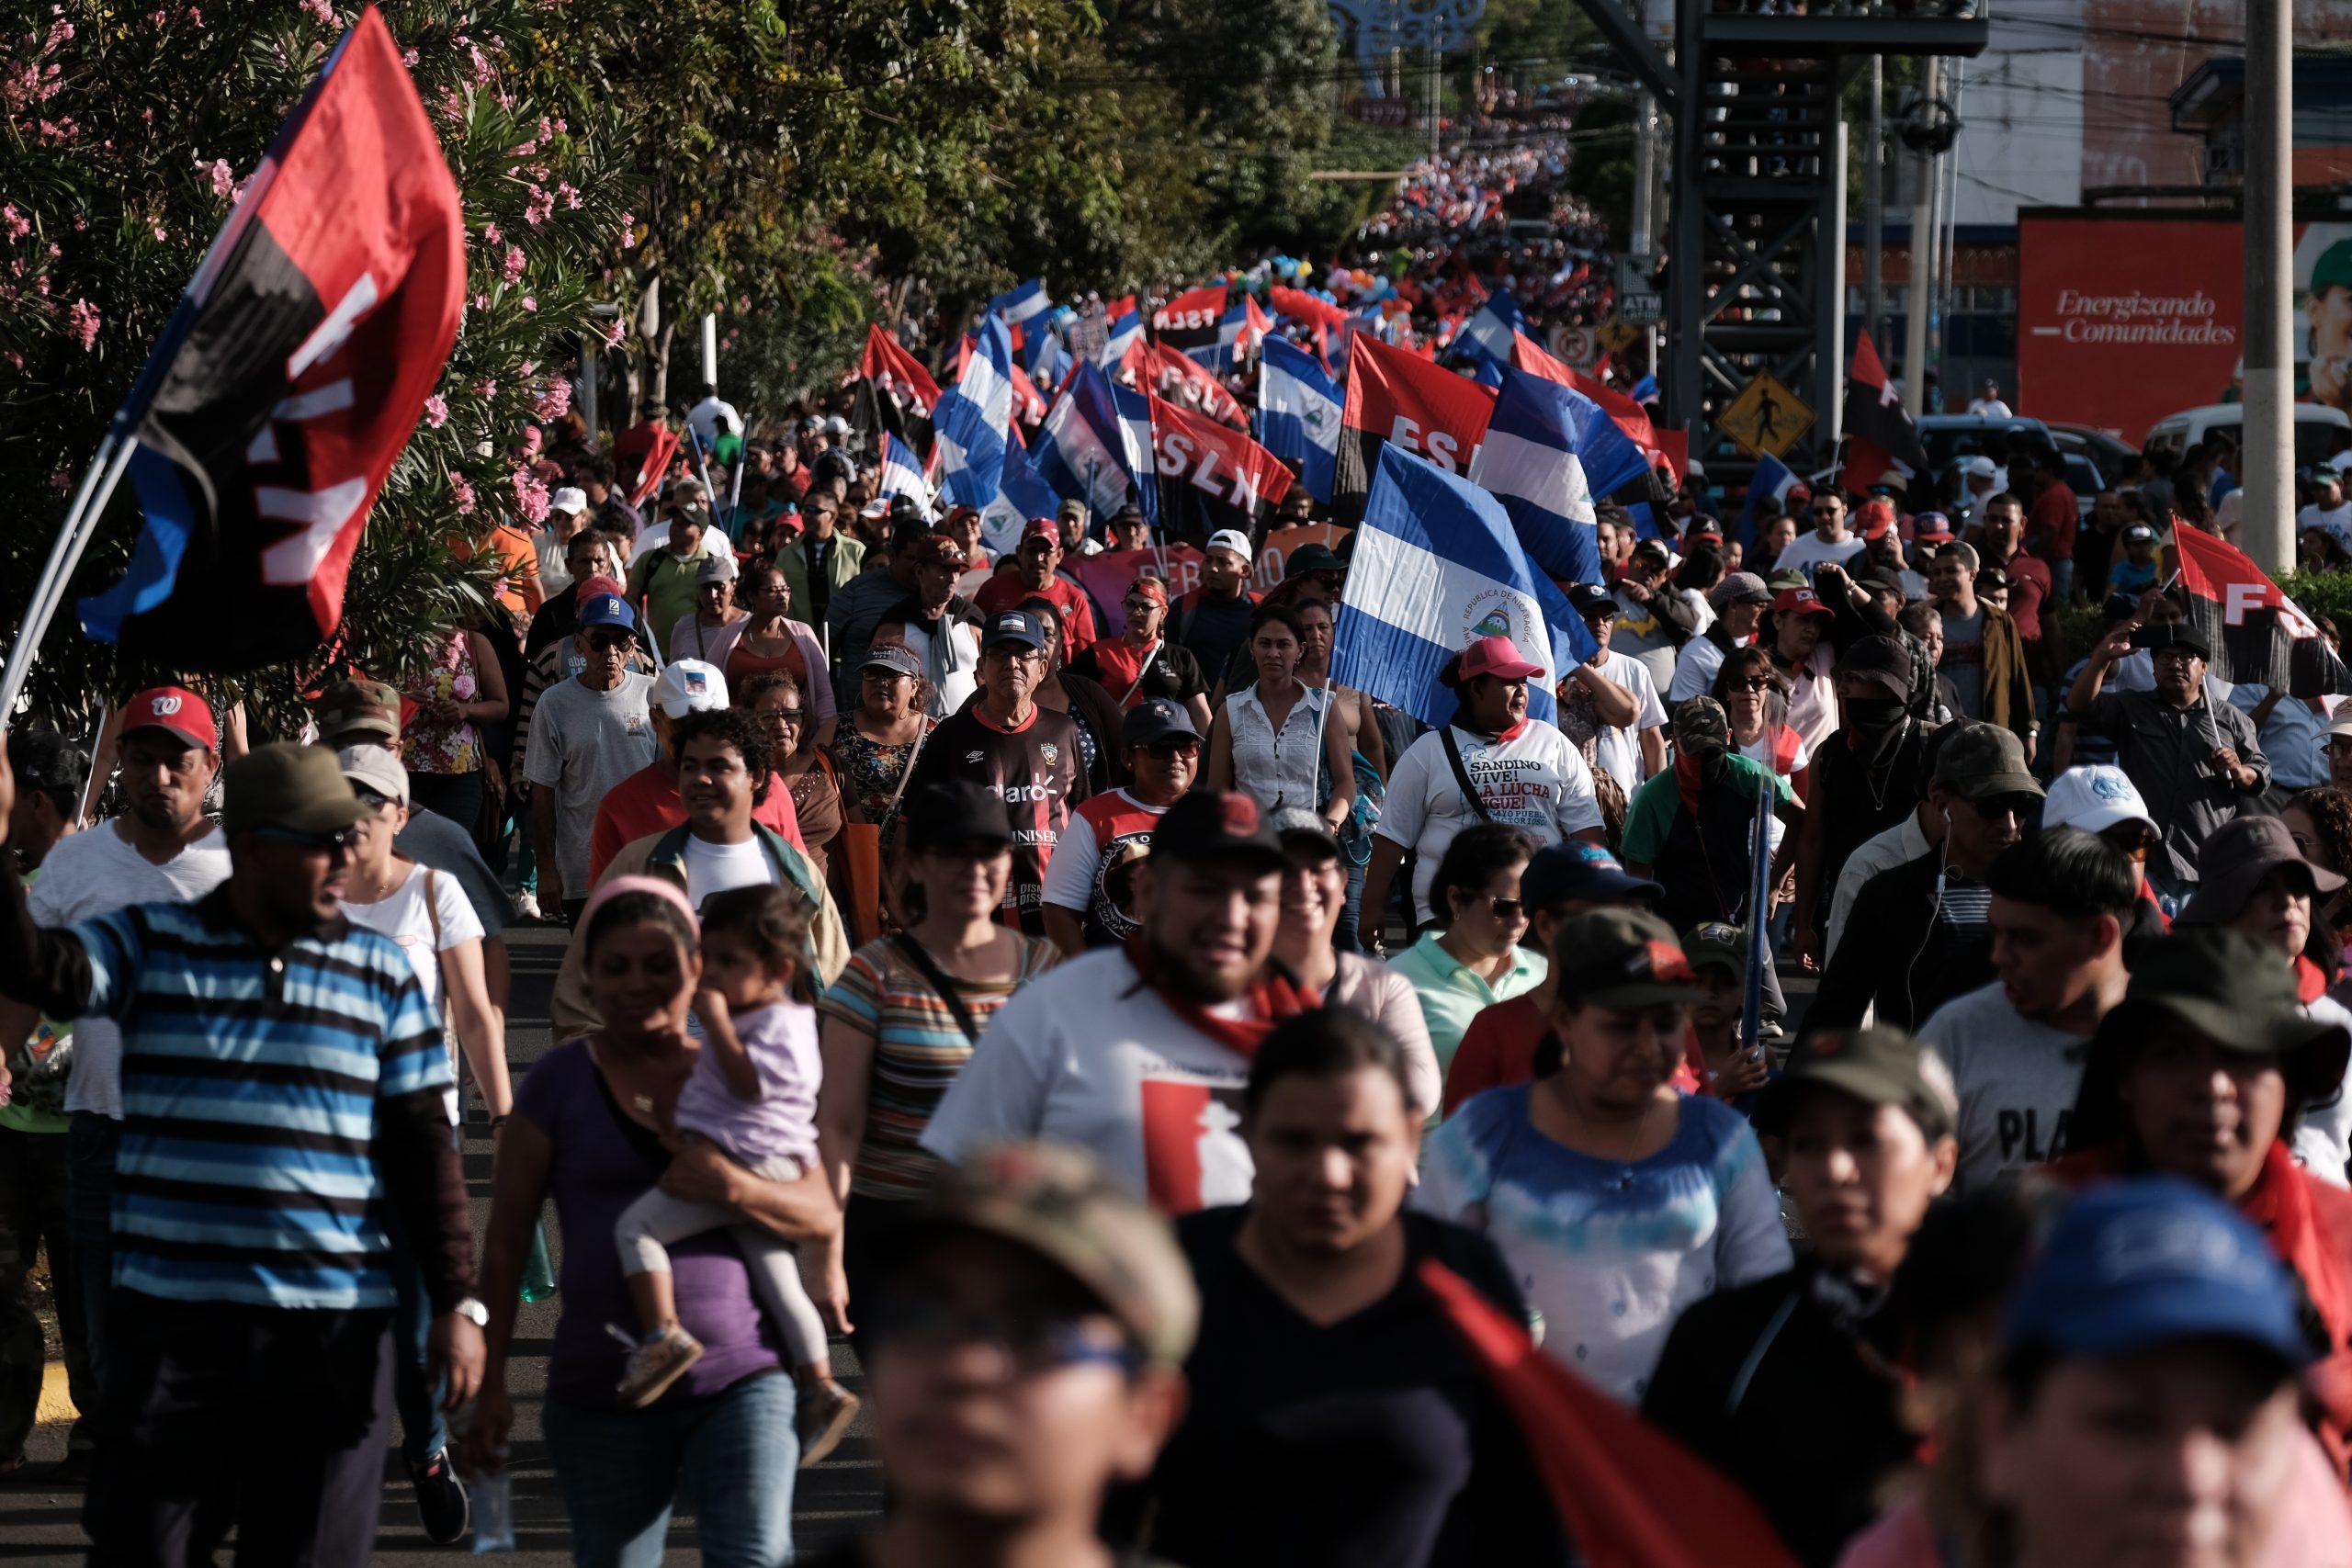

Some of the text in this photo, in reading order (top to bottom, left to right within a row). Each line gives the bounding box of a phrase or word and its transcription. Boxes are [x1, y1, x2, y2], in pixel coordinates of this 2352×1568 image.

[1623, 296, 1661, 309] ATM
[2056, 288, 2216, 321] Energizando
[2064, 317, 2237, 345] Comunidades
[1156, 426, 1261, 513] SLN
[1464, 590, 1531, 643] REPUBLICA DE NICARAGUA
[151, 696, 182, 716] W
[1470, 760, 1541, 772] SANDINO
[1470, 771, 1519, 784] VIVE!
[1499, 783, 1550, 799] LUCHA
[1482, 797, 1526, 810] IGUE!
